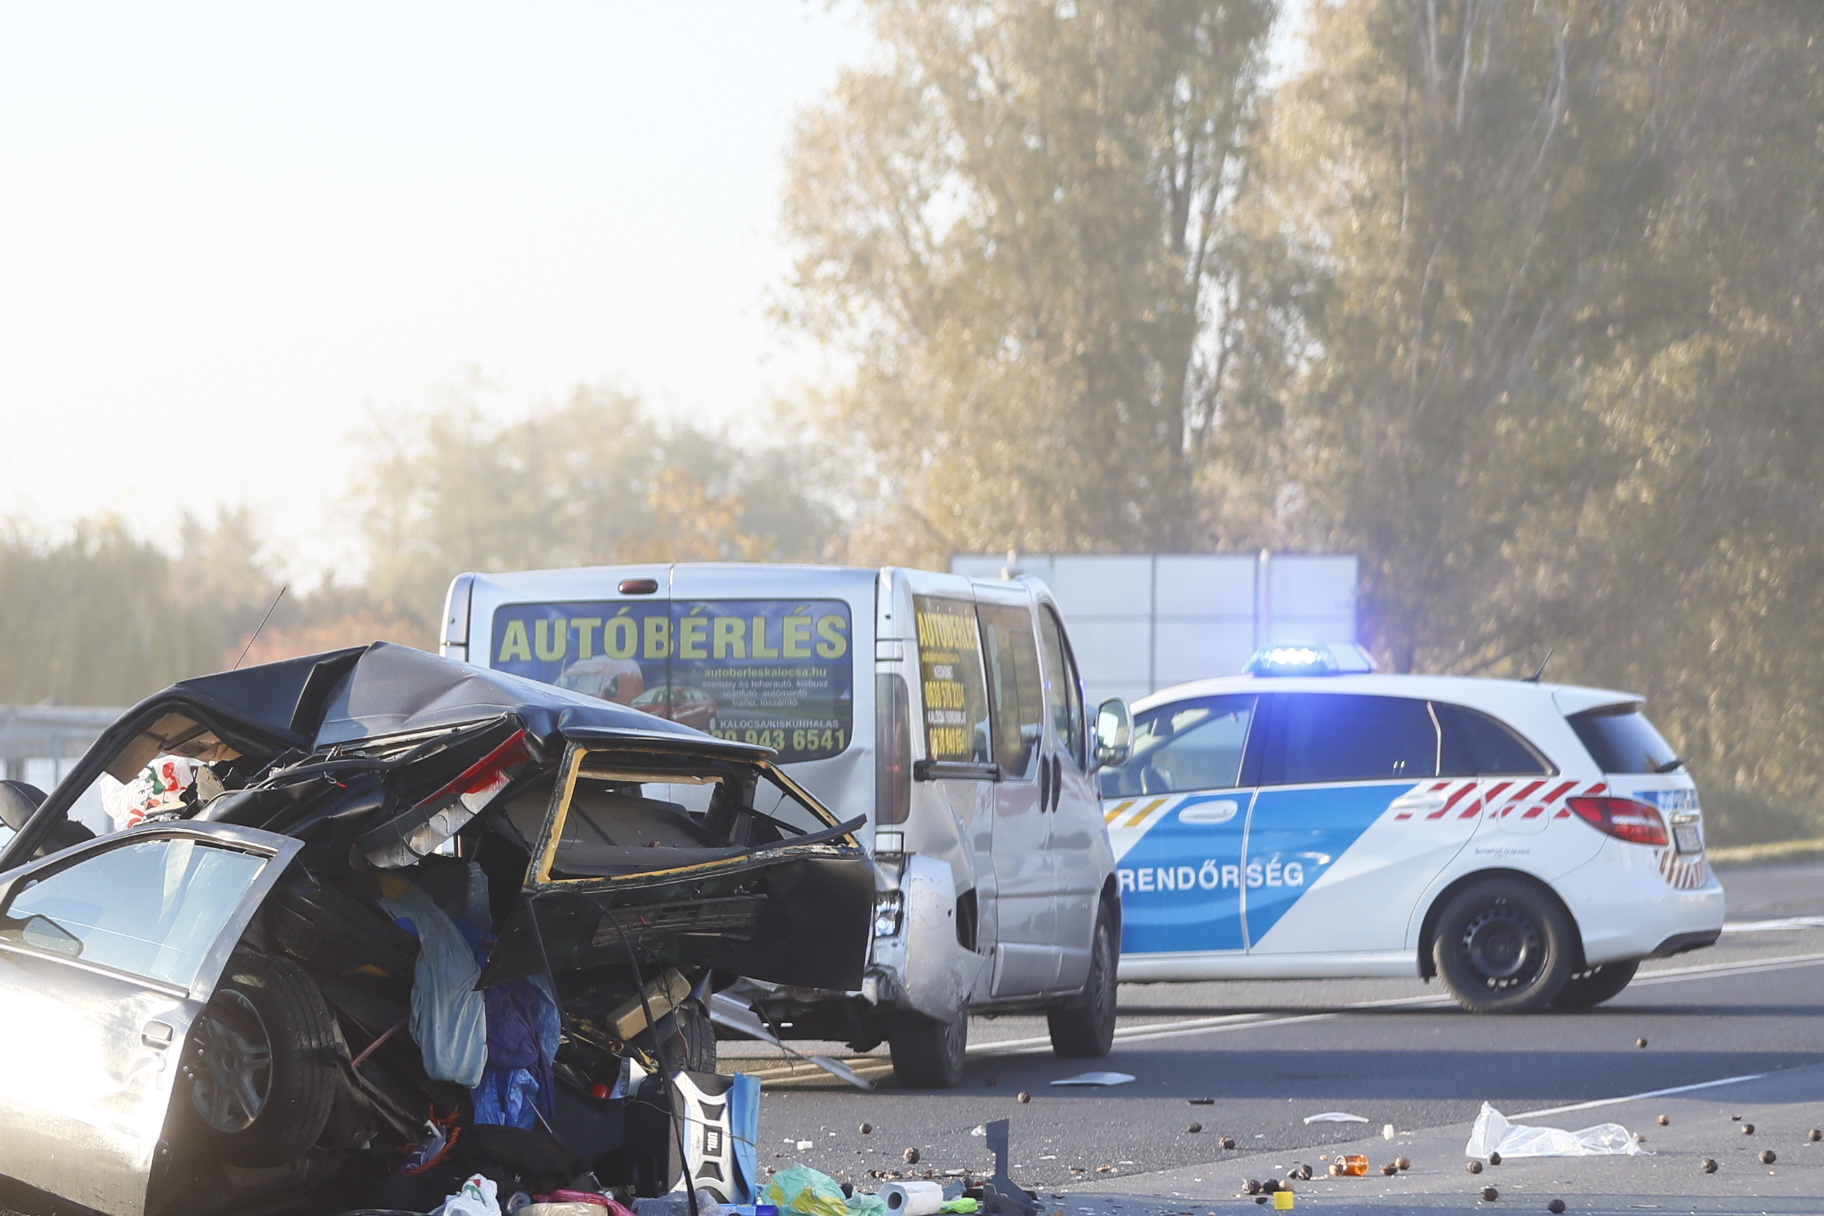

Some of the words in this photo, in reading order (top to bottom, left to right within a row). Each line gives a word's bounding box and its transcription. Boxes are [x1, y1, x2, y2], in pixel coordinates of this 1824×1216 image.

[498, 606, 848, 662] AUTÓBÉRLÉS
[704, 666, 827, 678] autoberleskalocsa.hu
[745, 729, 785, 751] 943
[793, 729, 846, 750] 6541
[1118, 853, 1304, 892] RENDŐRSÉG
